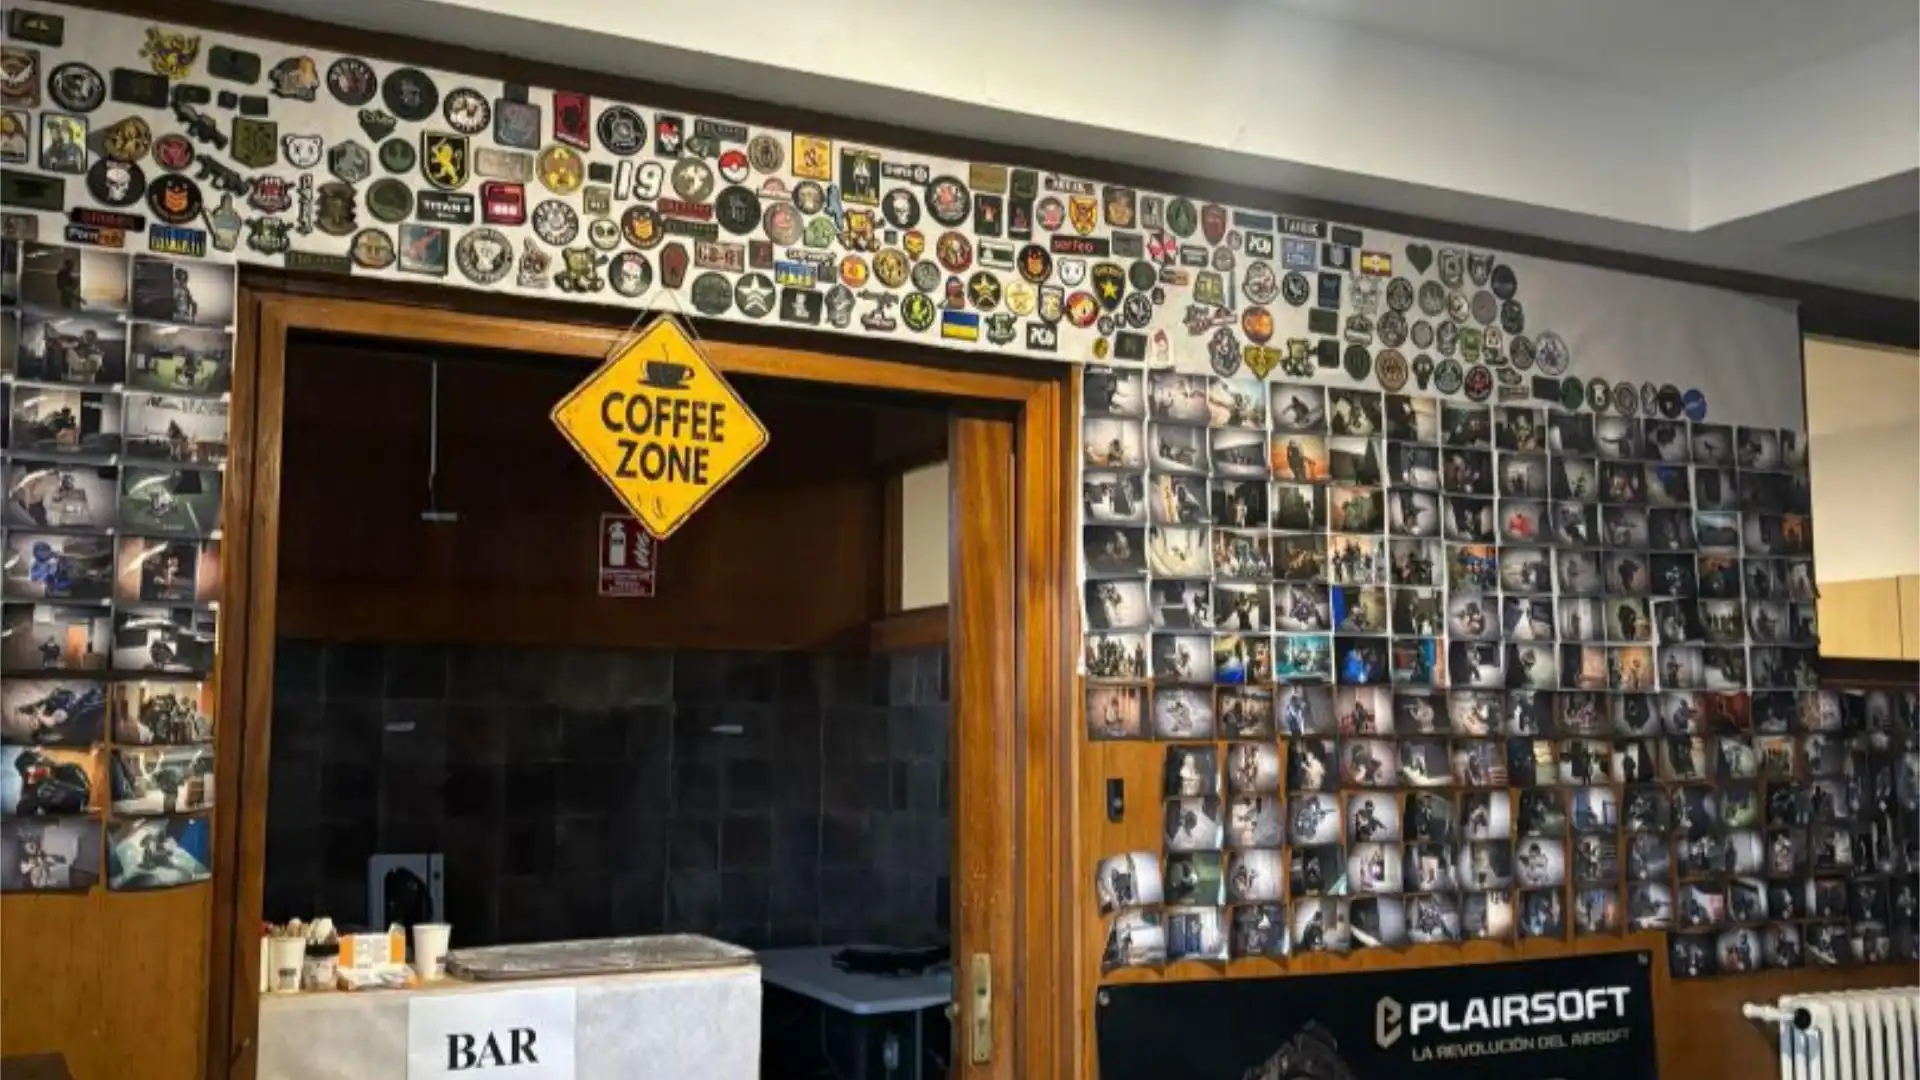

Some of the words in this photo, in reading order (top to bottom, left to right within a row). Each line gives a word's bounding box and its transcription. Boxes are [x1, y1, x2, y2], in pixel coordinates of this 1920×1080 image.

[615, 159, 665, 201] 19
[600, 391, 726, 443] COFFEE
[616, 439, 709, 485] ZONE
[1410, 986, 1631, 1035] PLAIRSOFT
[446, 1028, 539, 1070] BAR
[1412, 1045, 1433, 1062] LA
[1538, 1034, 1567, 1050] DEL
